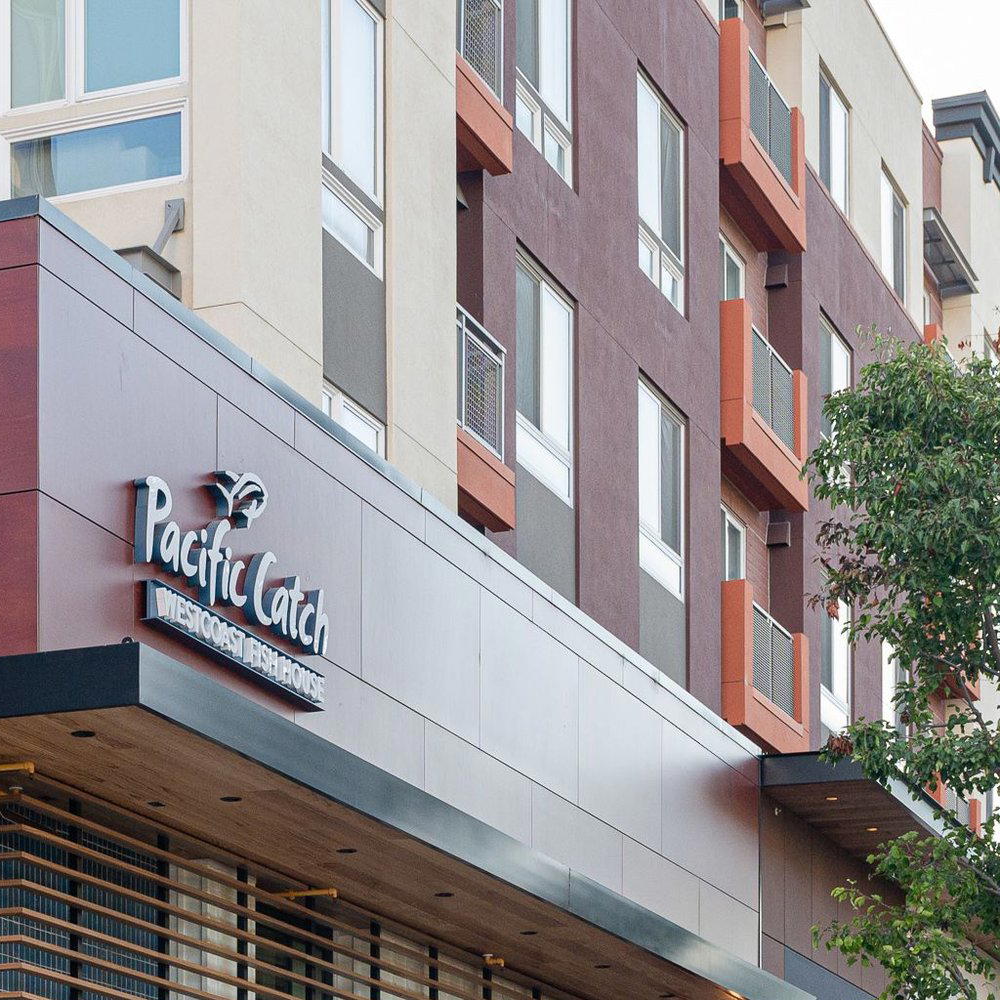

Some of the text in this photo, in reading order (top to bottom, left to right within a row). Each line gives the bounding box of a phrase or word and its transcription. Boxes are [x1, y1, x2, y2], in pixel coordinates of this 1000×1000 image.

[143, 476, 329, 655] Pacific Catch
[158, 588, 325, 703] WESTCOAST FISH HOUSE
